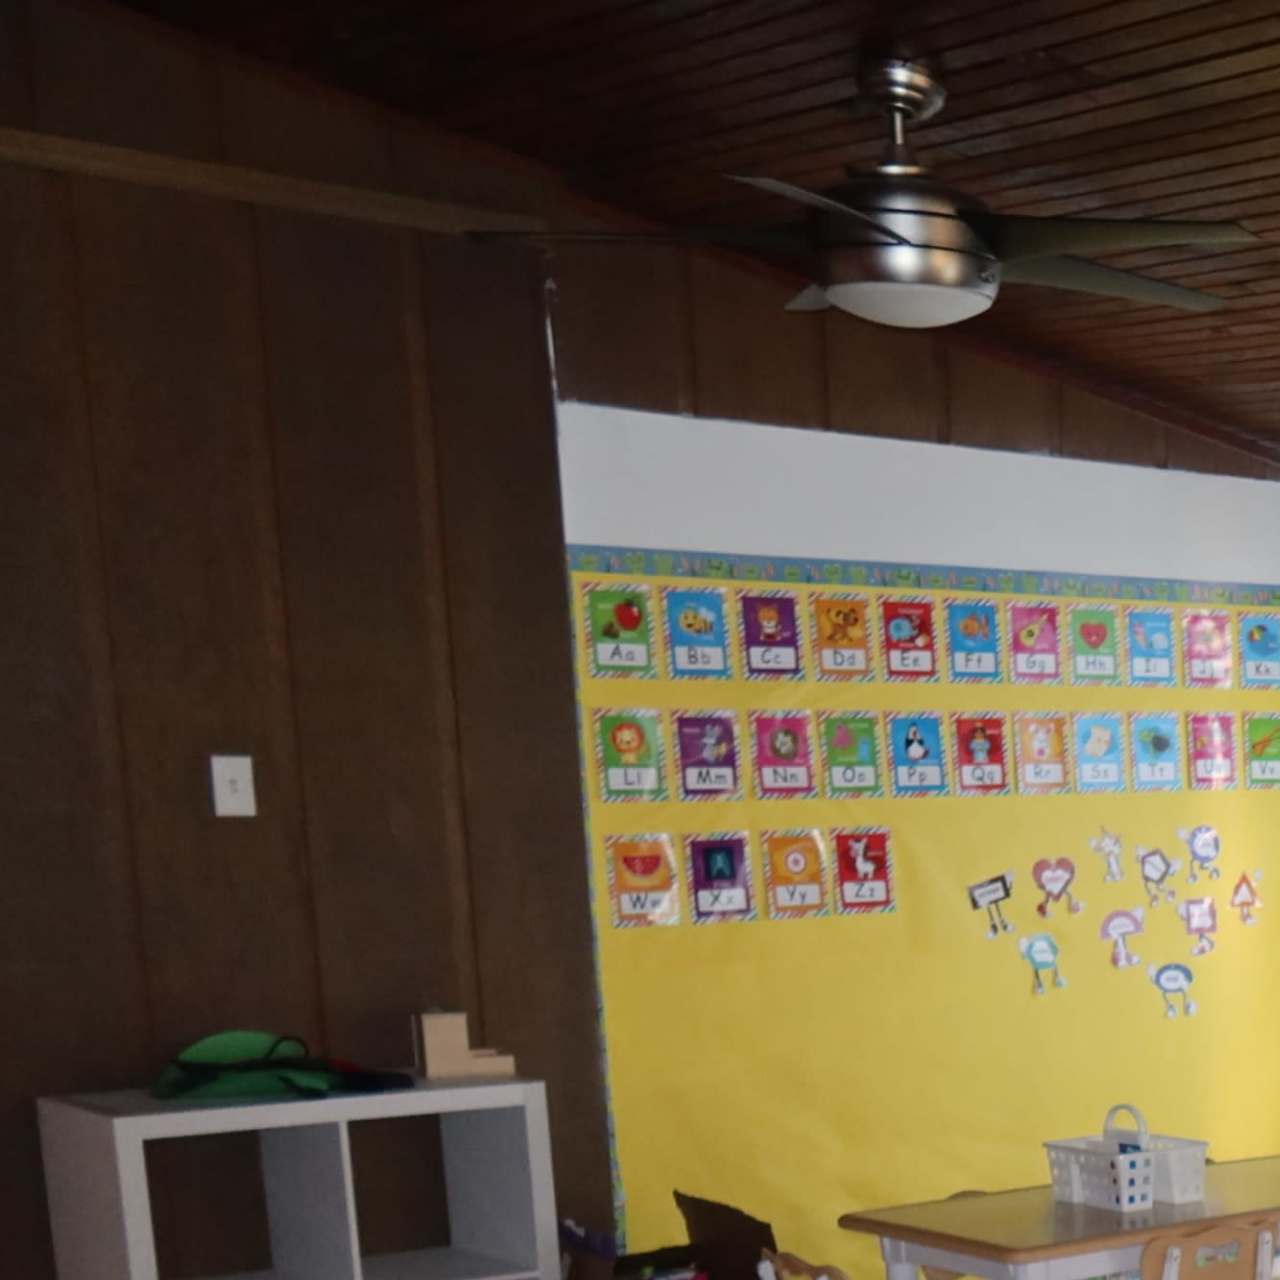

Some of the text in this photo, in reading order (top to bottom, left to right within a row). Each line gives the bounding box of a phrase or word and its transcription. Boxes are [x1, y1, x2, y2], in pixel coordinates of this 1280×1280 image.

[609, 643, 635, 662] Aa
[688, 650, 711, 666] Bb
[761, 650, 782, 666] Cc
[833, 650, 857, 667] Dd
[900, 650, 921, 668] Ee
[964, 651, 983, 668] Ff
[697, 769, 727, 787] Mm
[772, 766, 799, 783] Nn
[842, 766, 866, 784] Oo
[906, 767, 926, 786] Pp
[970, 766, 995, 784] Qq
[787, 885, 807, 903] Yy
[854, 882, 876, 898] Zz
